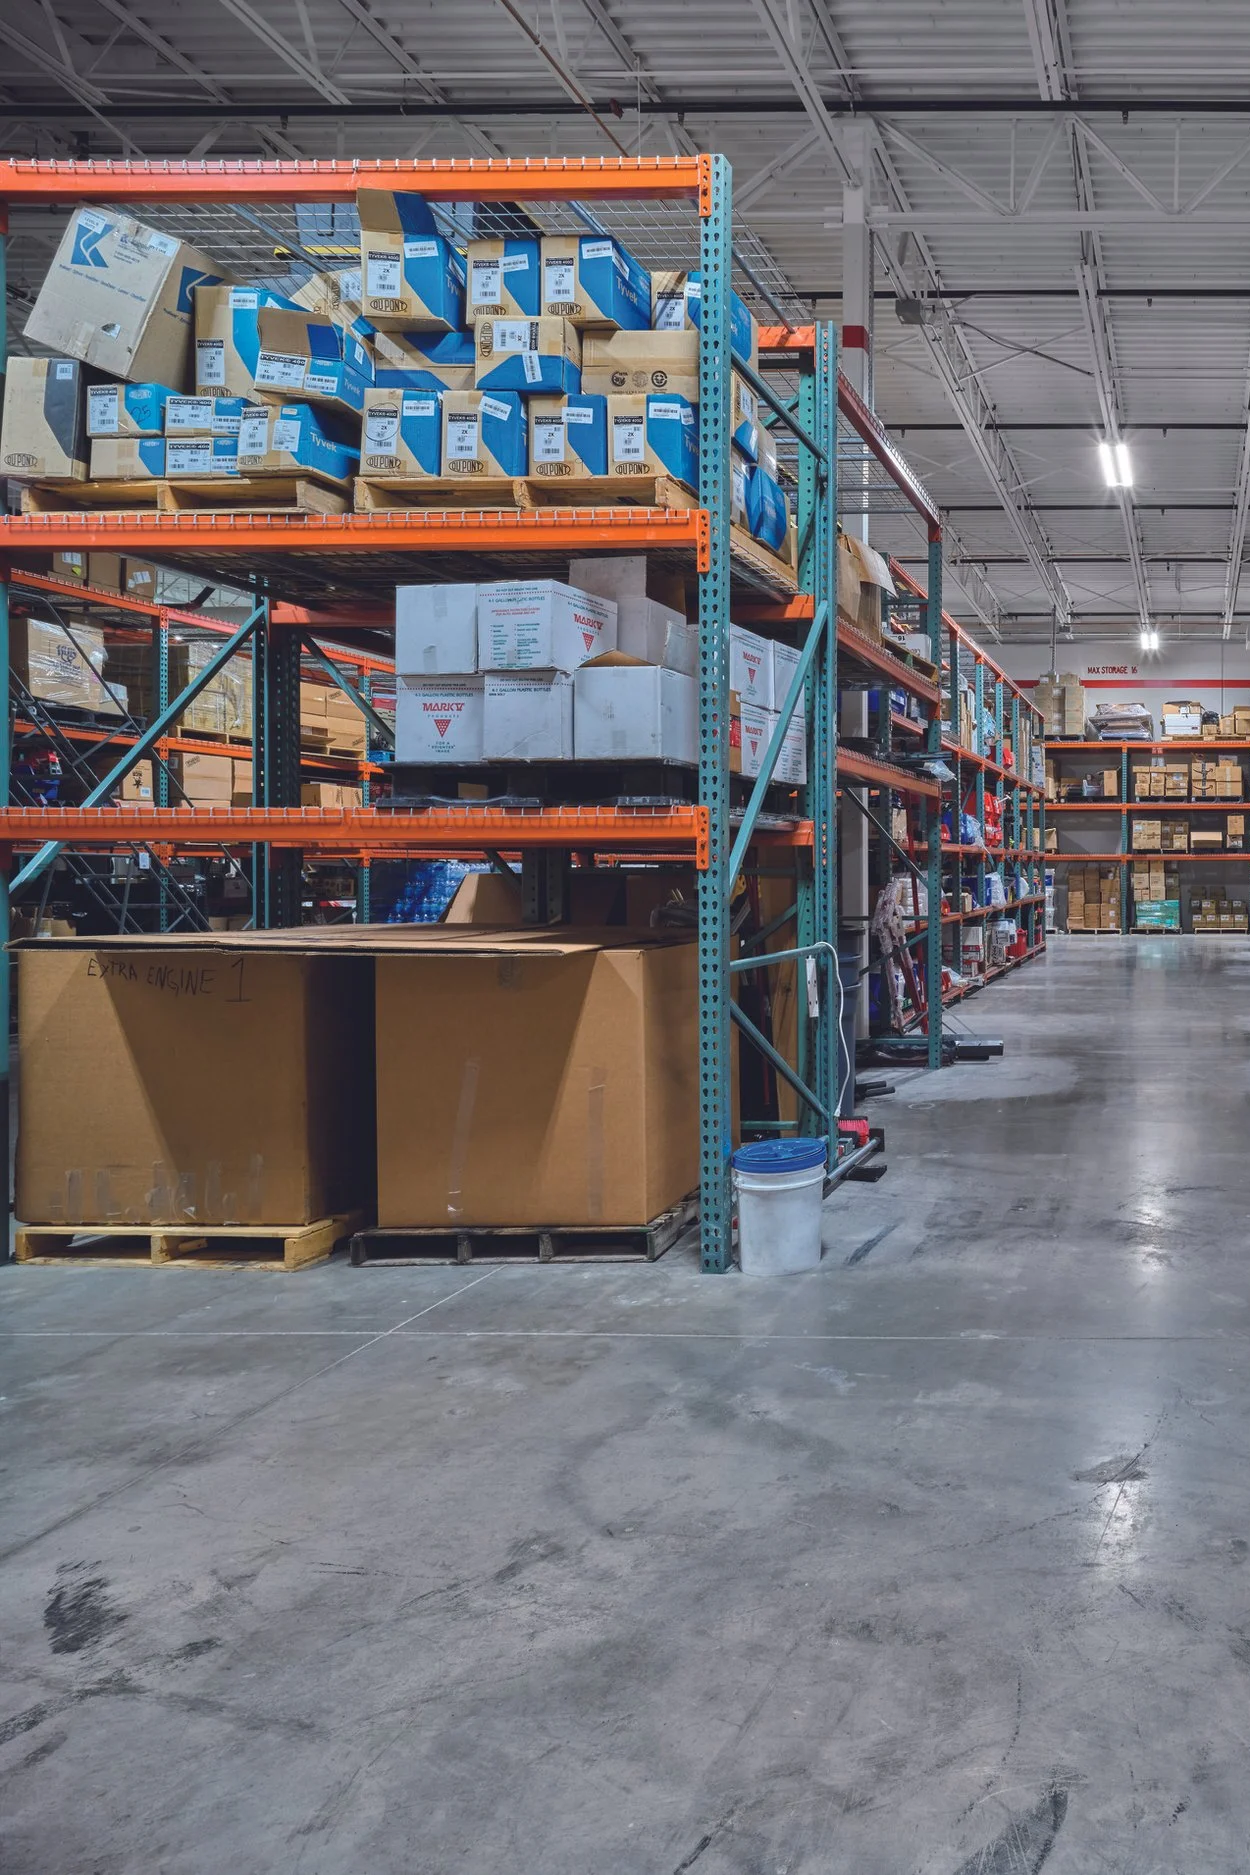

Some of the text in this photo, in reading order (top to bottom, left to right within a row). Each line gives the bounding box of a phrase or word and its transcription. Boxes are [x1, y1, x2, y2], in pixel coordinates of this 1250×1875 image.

[616, 277, 638, 306] Tyvek
[310, 432, 337, 453] Tyvek
[87, 958, 137, 980] EXTRA
[147, 966, 218, 997] ENGINE
